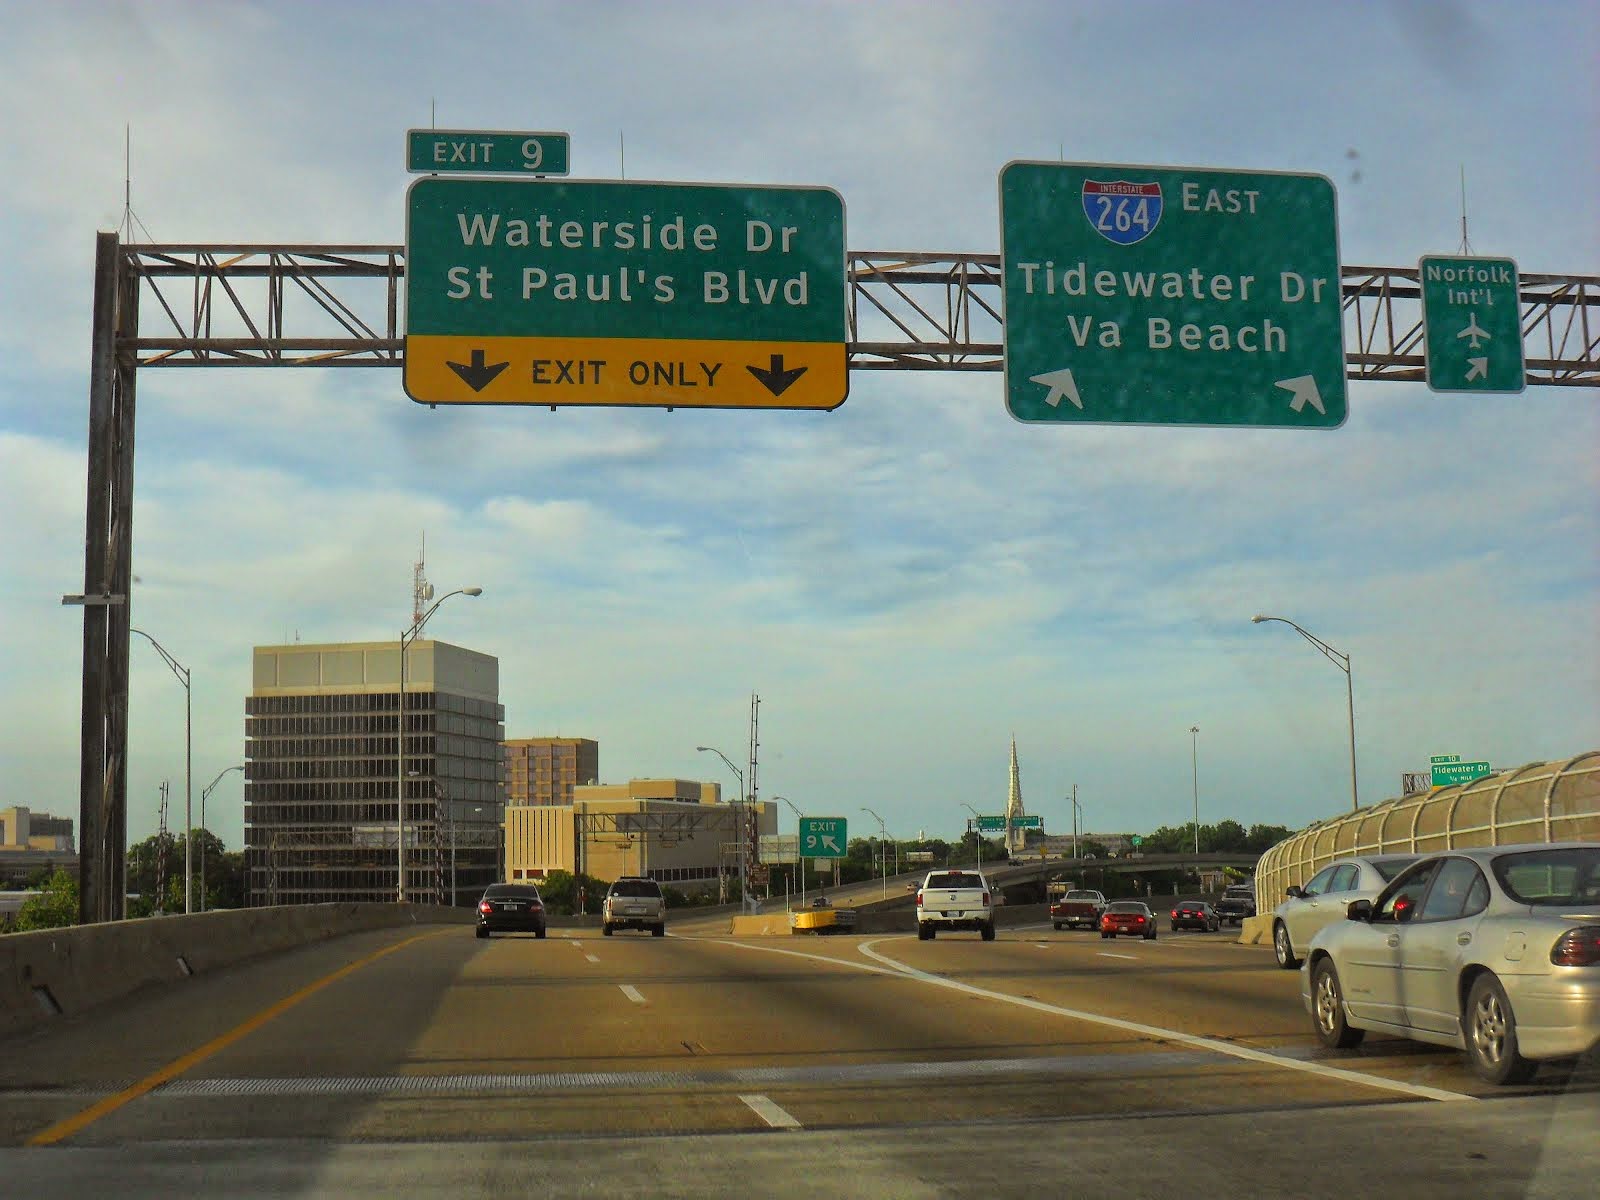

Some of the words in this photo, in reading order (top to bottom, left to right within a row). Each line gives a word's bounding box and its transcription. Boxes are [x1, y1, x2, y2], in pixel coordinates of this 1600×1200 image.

[433, 141, 494, 164] EXIT
[521, 138, 544, 170] 9
[1100, 183, 1144, 195] INTERSTATE
[1182, 182, 1260, 214] EAST
[1096, 195, 1150, 233] 264
[457, 213, 718, 251] Waterside
[745, 220, 798, 253] Dr
[446, 266, 494, 300] St
[522, 267, 676, 303] Paul's
[703, 270, 808, 306] Blvd
[1018, 262, 1254, 301] Tidewater
[1280, 272, 1328, 304] Dr
[1427, 265, 1510, 283] Norfolk
[1448, 288, 1494, 306] Int'l
[1067, 316, 1122, 348] Va
[1148, 317, 1287, 353] Beach
[532, 360, 607, 386] EXIT
[628, 360, 724, 387] ONLY
[807, 835, 816, 848] 9
[810, 822, 836, 831] EXIT
